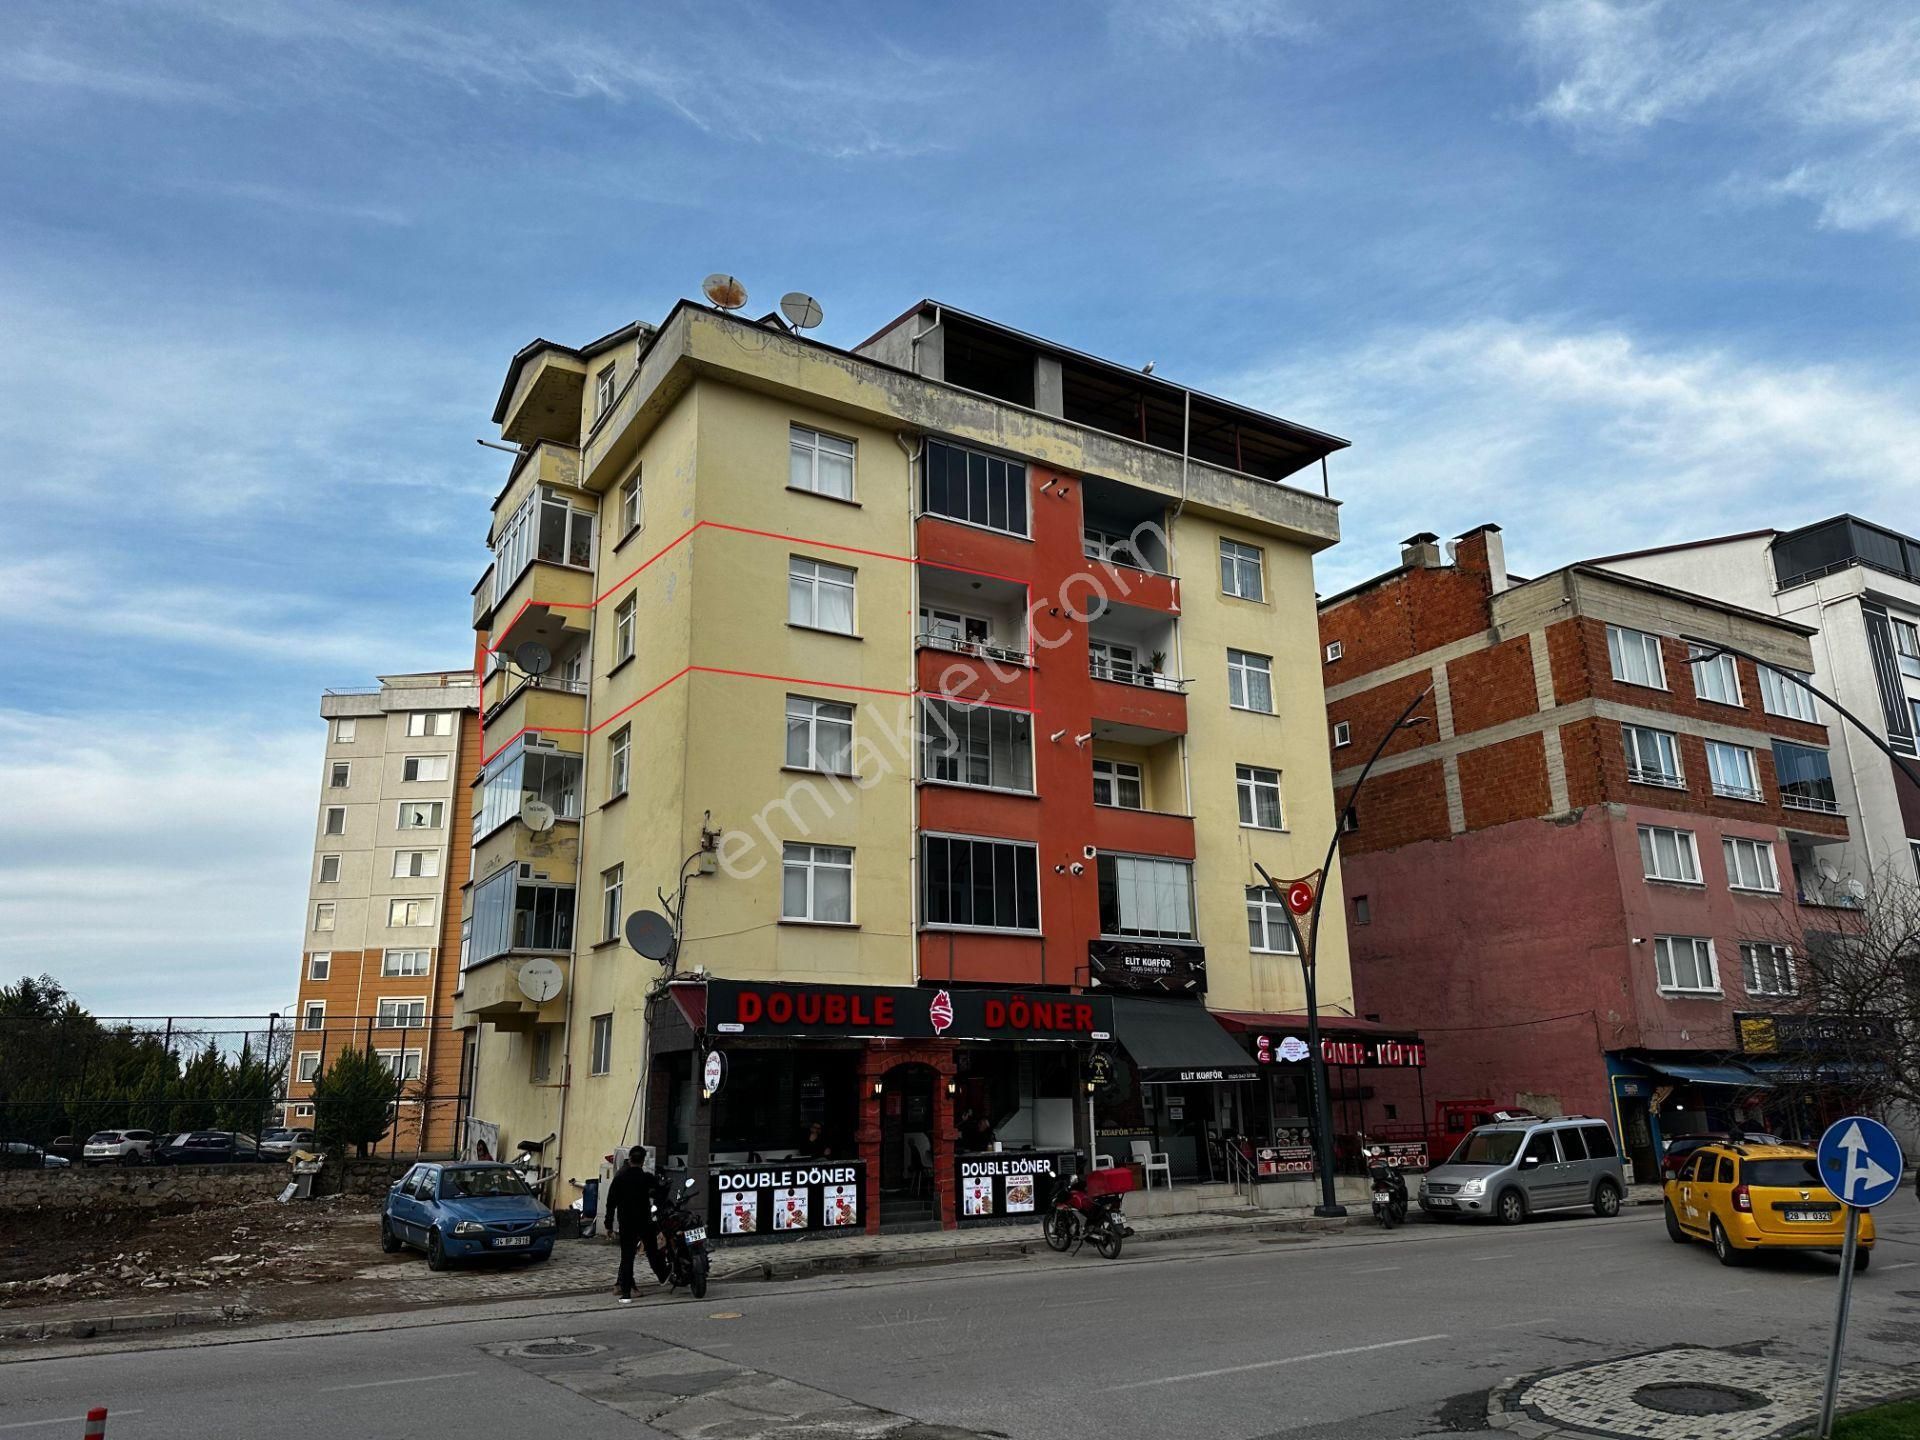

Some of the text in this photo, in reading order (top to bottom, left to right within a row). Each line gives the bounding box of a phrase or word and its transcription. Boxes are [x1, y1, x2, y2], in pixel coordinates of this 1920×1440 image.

[1125, 956, 1140, 965] ELİT
[737, 992, 1094, 1032] DOUBLE DÖNER
[1320, 1037, 1366, 1065] ÖNER
[1376, 1040, 1426, 1066] KÖFTE
[1180, 1070, 1194, 1080] ELİT
[1196, 1069, 1223, 1080] KUAFÖR
[962, 1158, 1051, 1177] DOUBLE DÖNER
[718, 1167, 856, 1190] DOUBLE DÖNER
